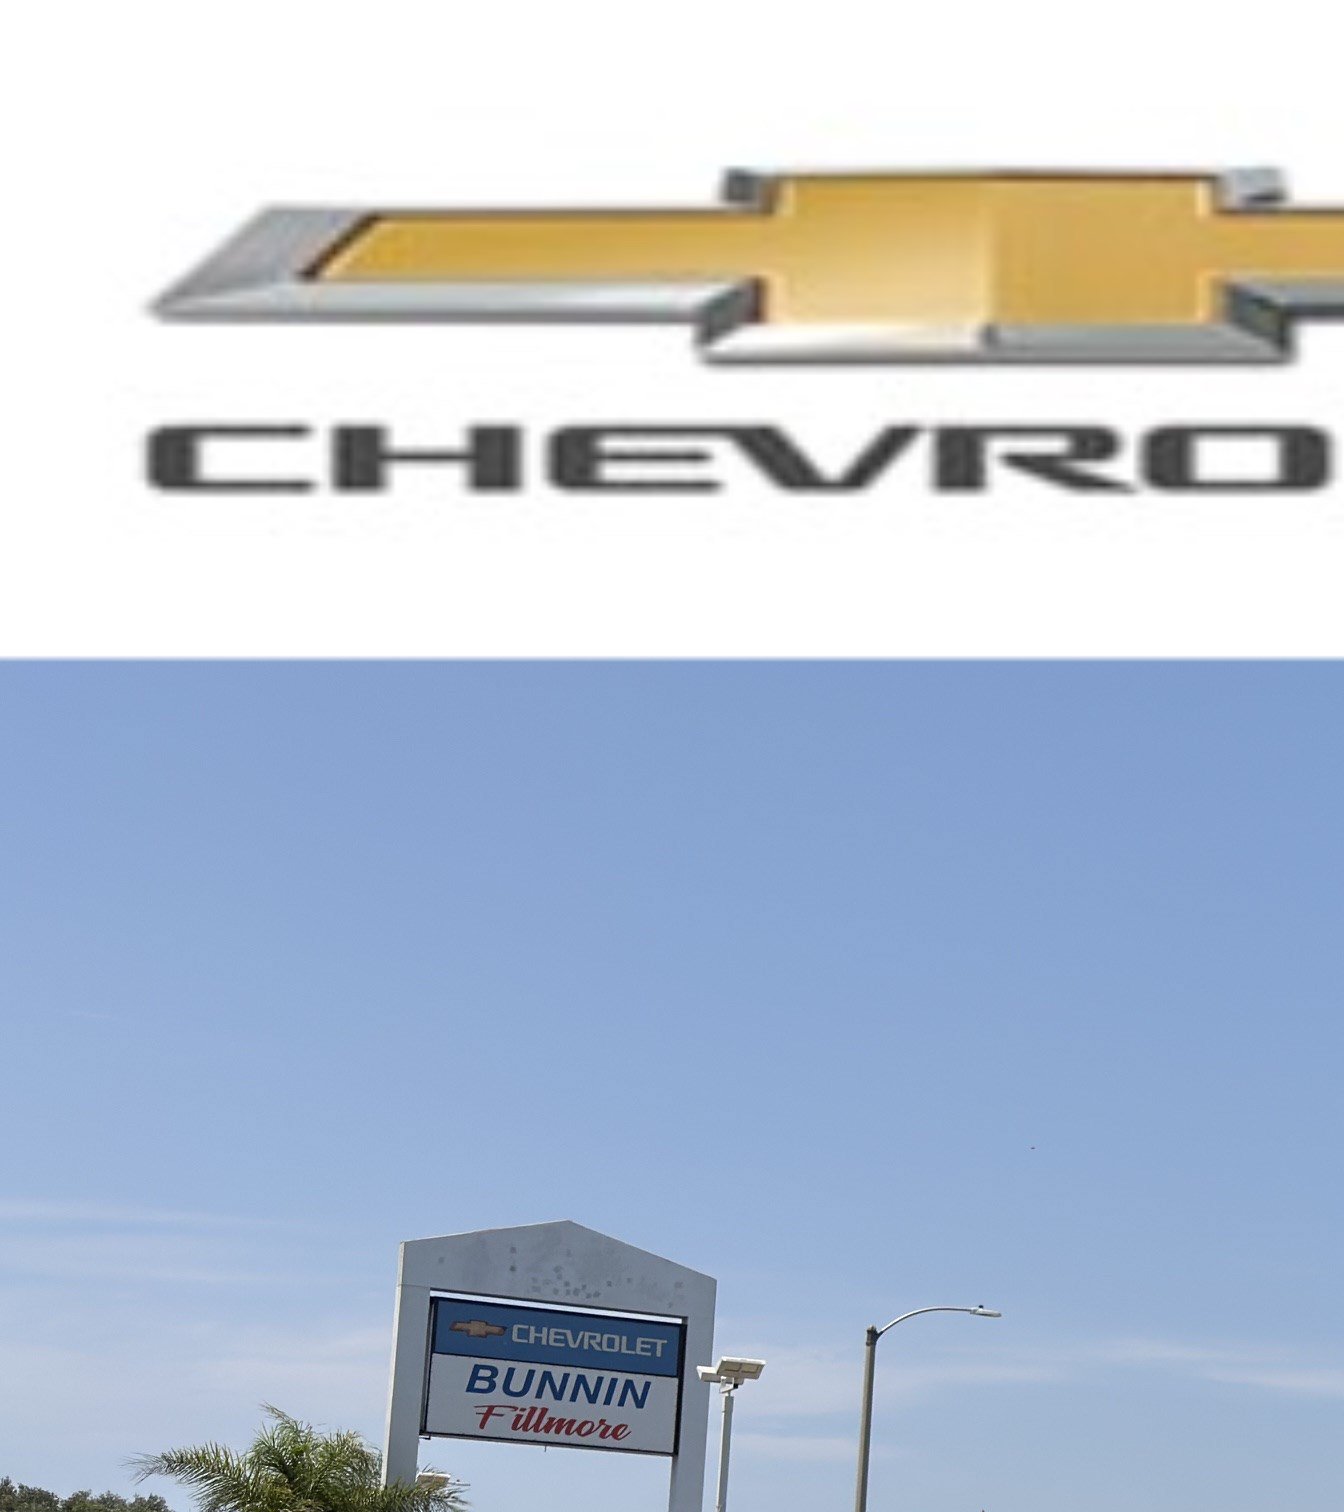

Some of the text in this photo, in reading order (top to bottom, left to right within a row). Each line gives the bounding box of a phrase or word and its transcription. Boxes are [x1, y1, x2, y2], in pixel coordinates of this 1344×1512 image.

[511, 1323, 668, 1358] CHEVROLET
[465, 1363, 652, 1410] BUNNIN
[473, 1404, 632, 1441] Fillmore
